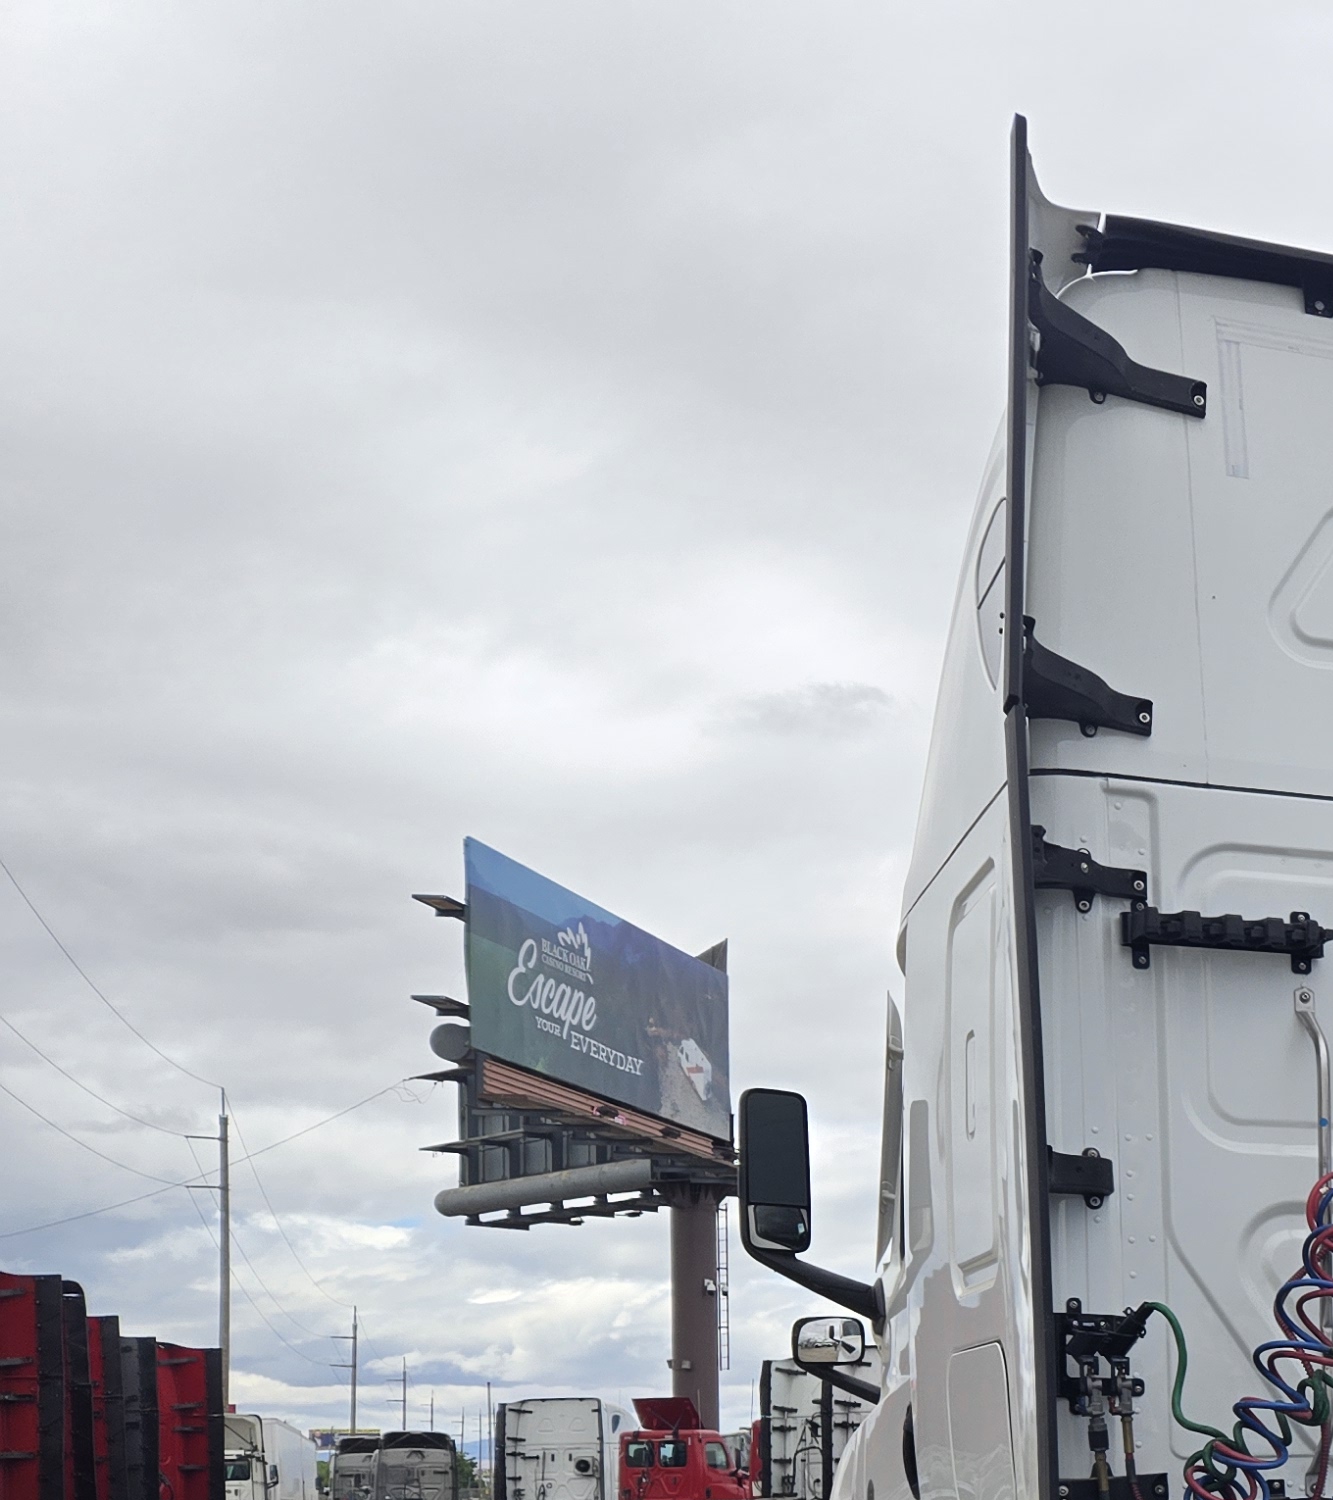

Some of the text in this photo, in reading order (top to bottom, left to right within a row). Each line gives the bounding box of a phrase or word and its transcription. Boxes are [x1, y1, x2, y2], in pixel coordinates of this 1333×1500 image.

[541, 938, 587, 971] BLACK OAK
[508, 938, 597, 1039] Escape
[535, 1016, 644, 1075] YOUR EVERYDAY
